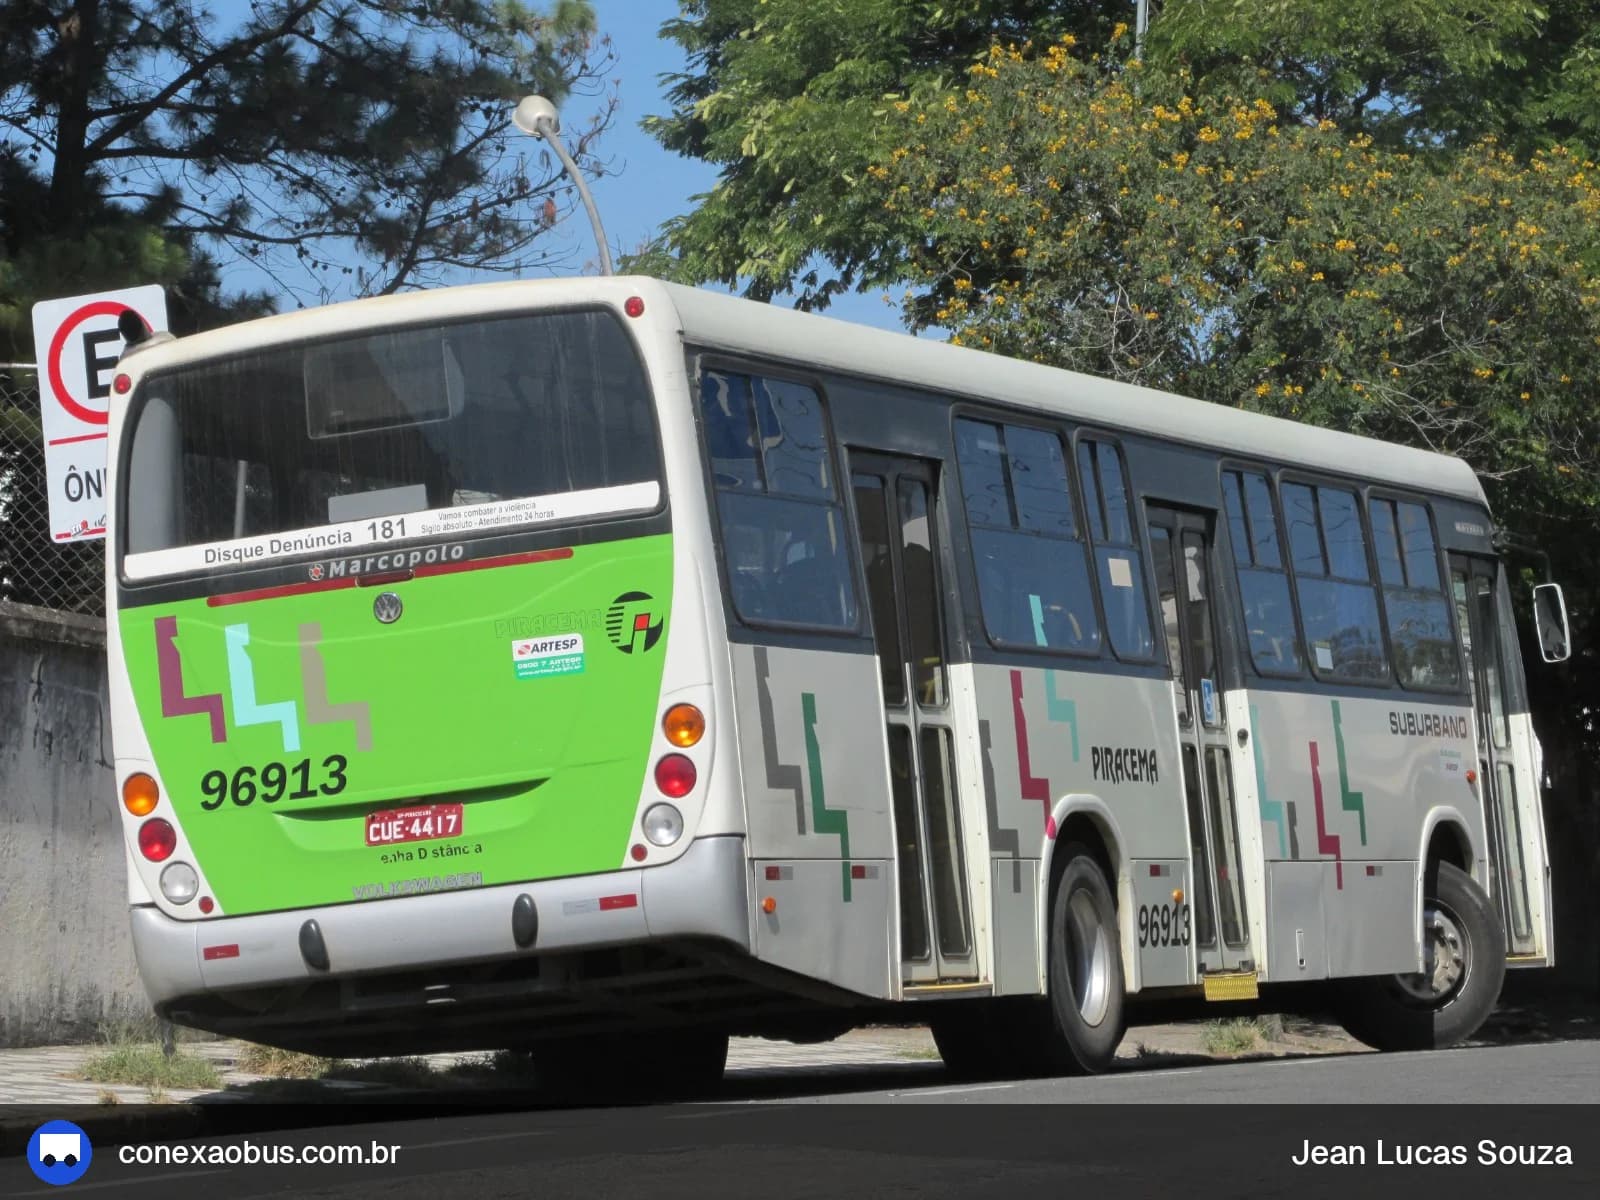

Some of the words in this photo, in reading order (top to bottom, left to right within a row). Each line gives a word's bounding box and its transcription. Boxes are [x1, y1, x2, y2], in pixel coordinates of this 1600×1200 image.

[65, 465, 107, 502] ÔN
[421, 523, 441, 534] Sigilo
[442, 519, 473, 532] absoluto
[478, 512, 523, 527] Atendimento
[524, 510, 533, 521] 24
[534, 509, 555, 519] horas
[438, 511, 462, 521] Vamos
[464, 506, 497, 518] combater
[505, 502, 536, 511] violência
[204, 545, 264, 566] Disque
[269, 530, 352, 555] Denúncia
[367, 517, 407, 542] 181
[328, 545, 465, 579] Marcopolo
[531, 638, 578, 654] ARTESP
[1389, 711, 1467, 739] SUBURBANO
[199, 754, 348, 812] 96913
[1091, 746, 1159, 786] PIRACEMA
[352, 871, 484, 900] VOLKSWAGEN
[1138, 903, 1191, 949] 96913
